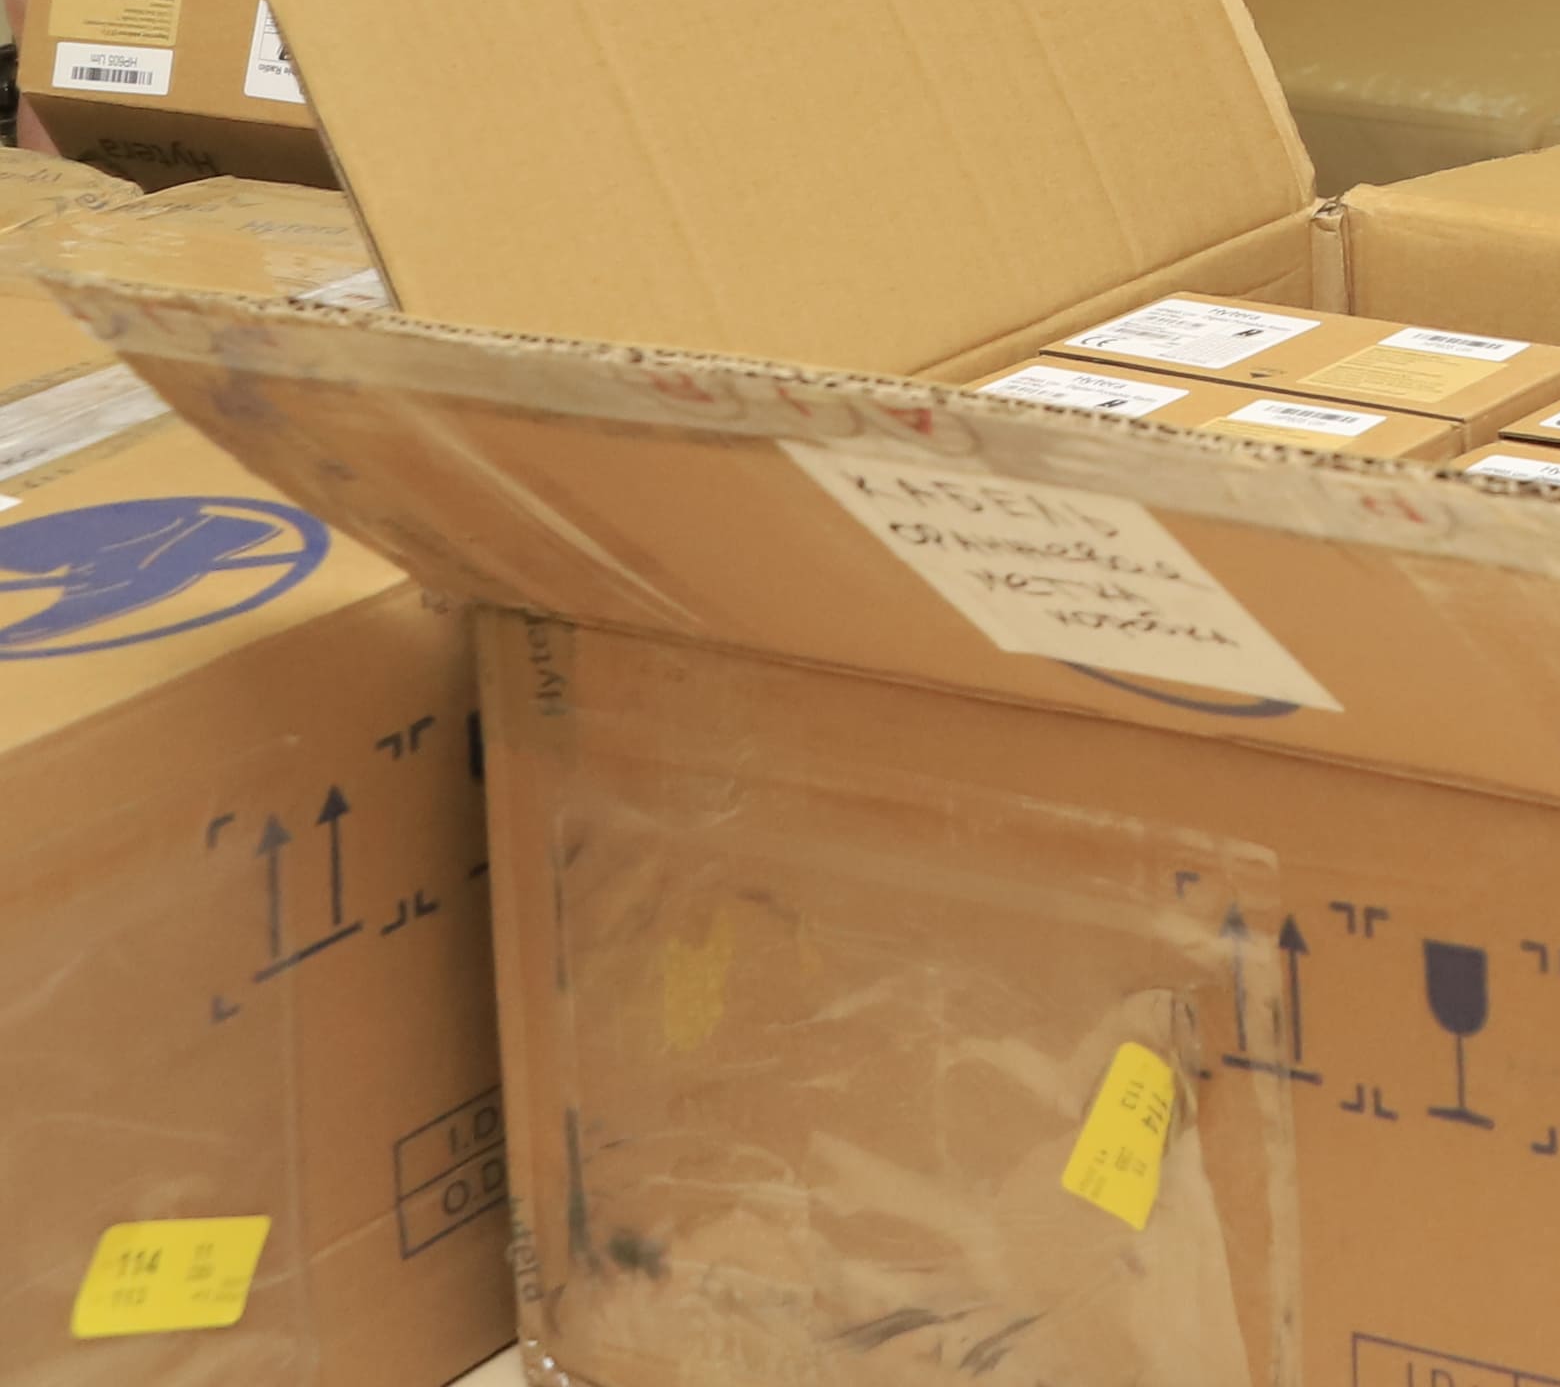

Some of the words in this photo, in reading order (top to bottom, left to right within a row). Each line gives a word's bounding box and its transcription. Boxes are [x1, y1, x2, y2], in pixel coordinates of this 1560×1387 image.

[101, 138, 219, 175] Hytera
[1207, 307, 1262, 322] Hytera
[1073, 375, 1128, 390] Hytera
